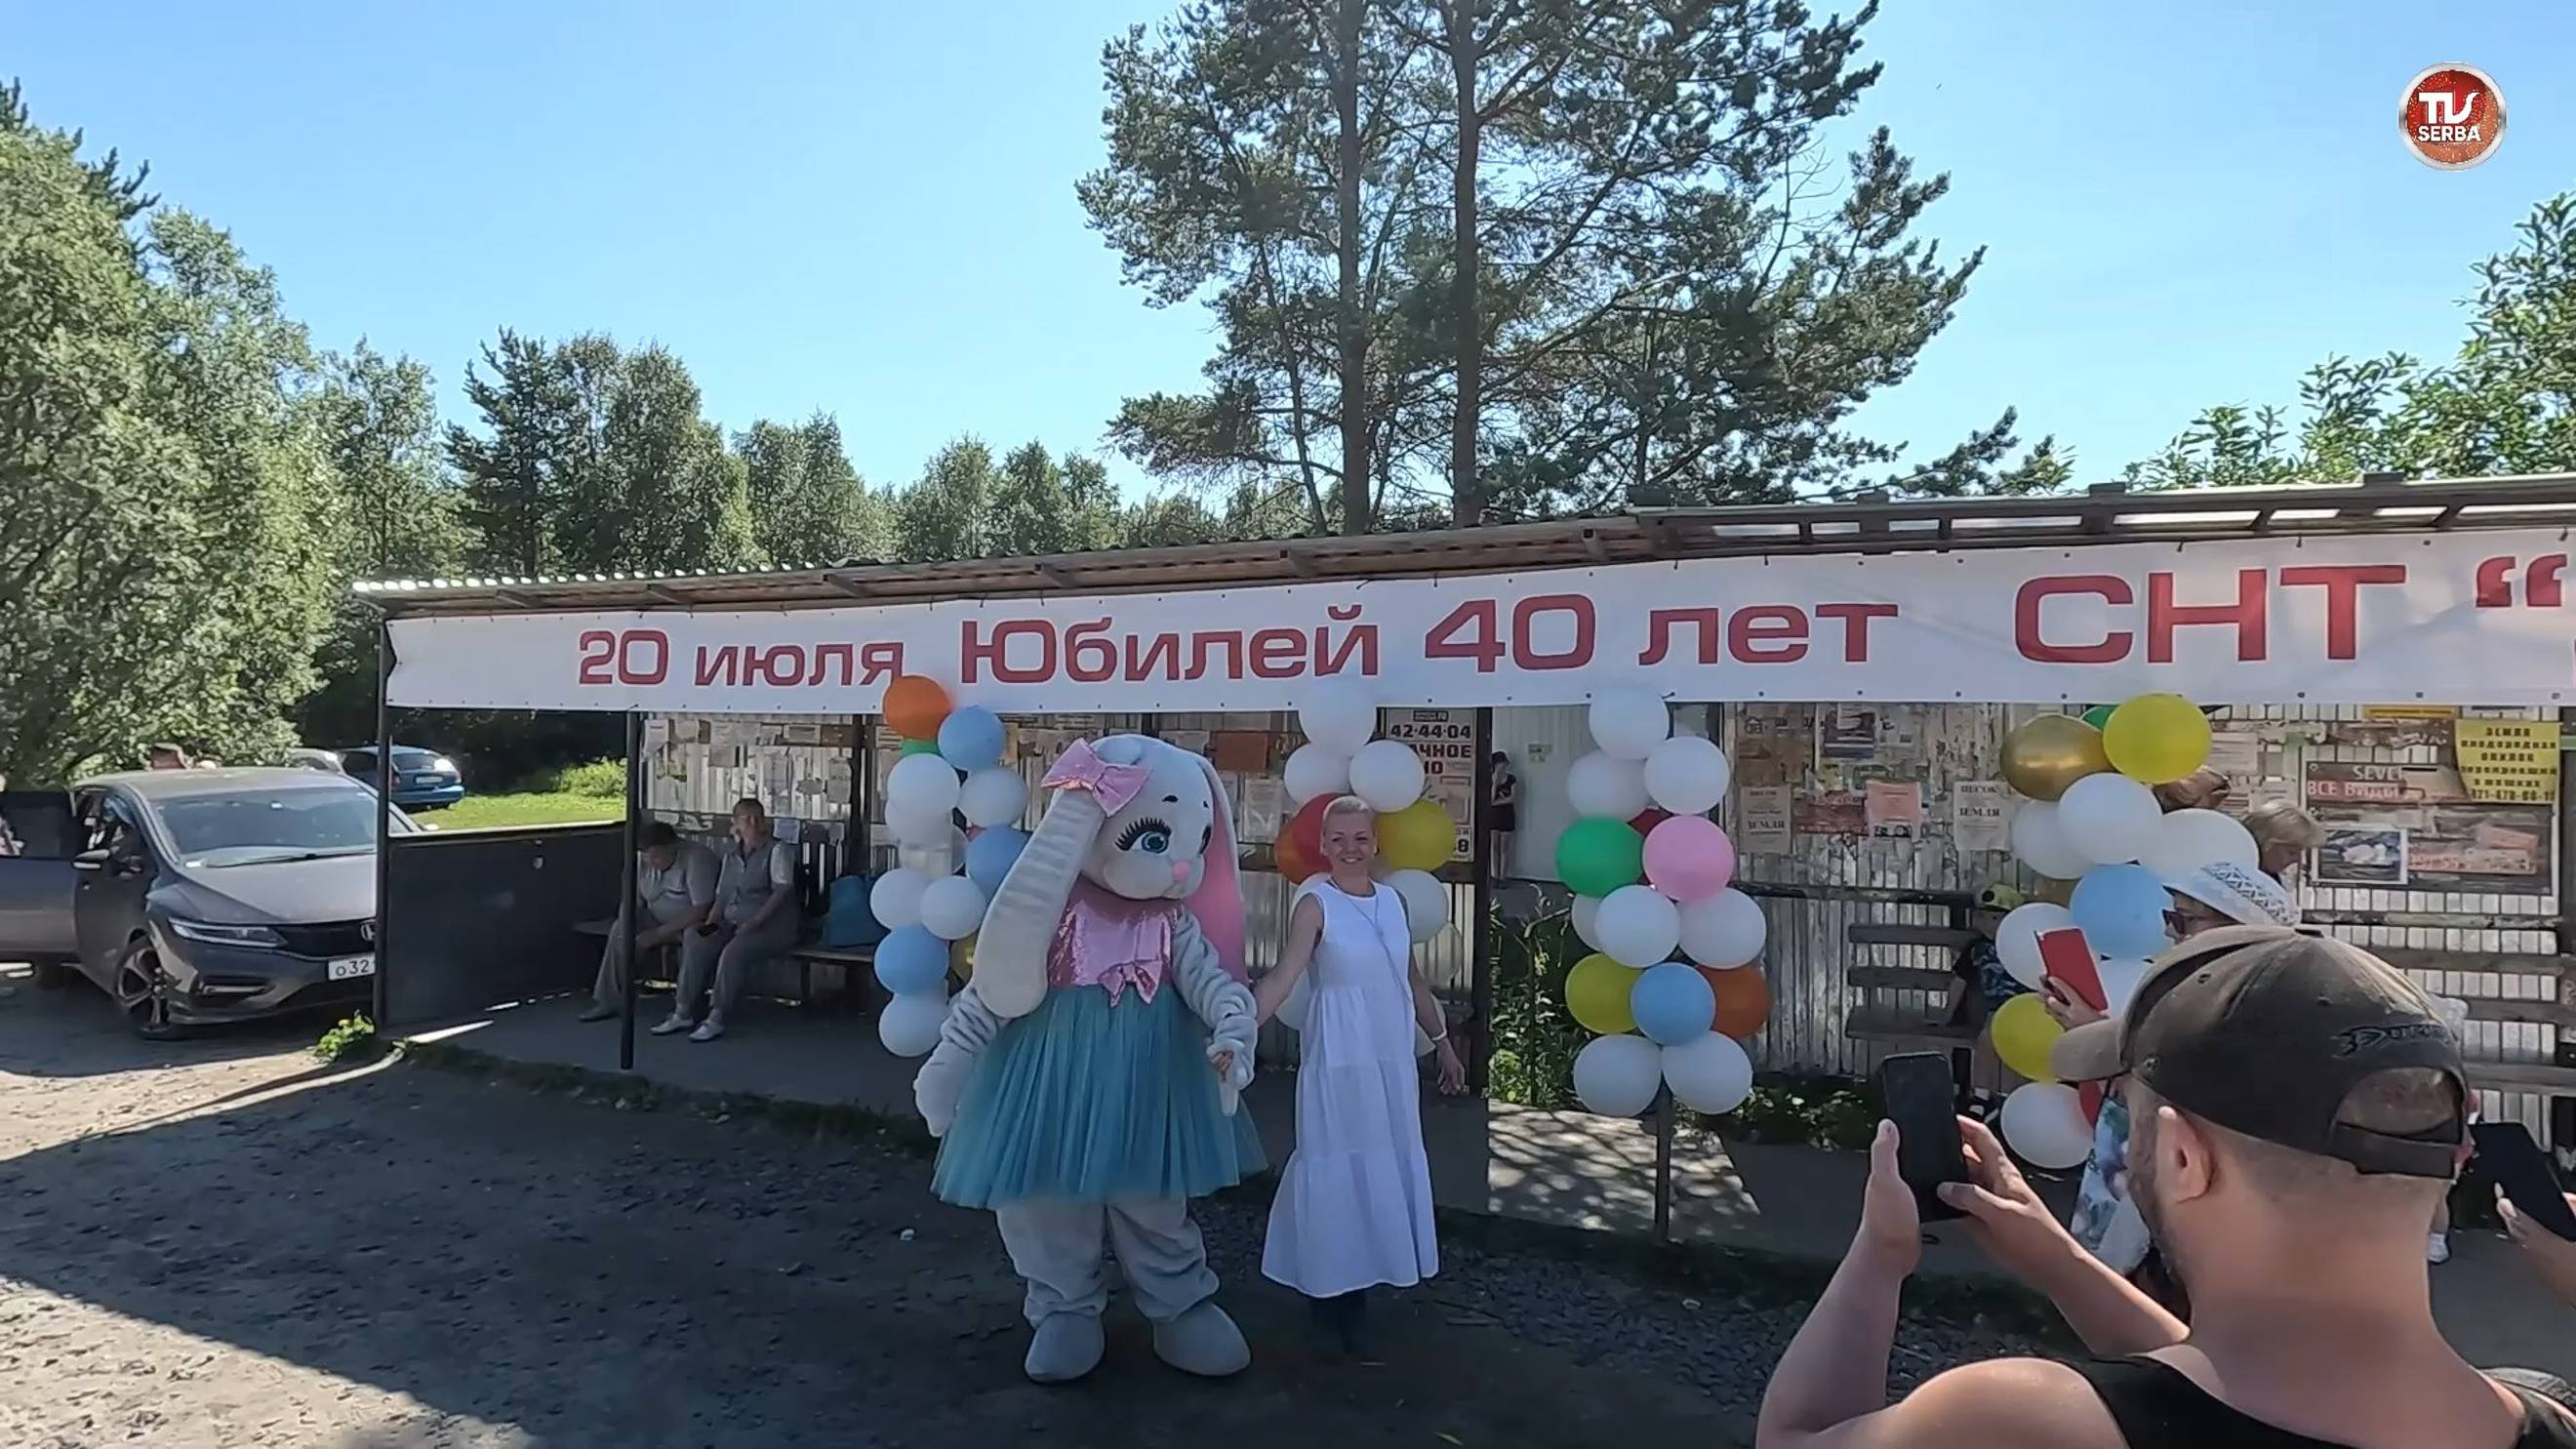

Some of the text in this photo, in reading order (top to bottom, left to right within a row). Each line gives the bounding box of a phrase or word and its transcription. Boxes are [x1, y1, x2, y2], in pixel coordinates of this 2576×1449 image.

[580, 630, 669, 685] 20
[694, 642, 905, 687] июля
[960, 603, 1379, 684] Юбилей
[1425, 593, 1596, 672] 40
[1638, 603, 1899, 665] лет
[2015, 564, 2407, 664] СНТ
[2307, 781, 2338, 796] ВСЕ
